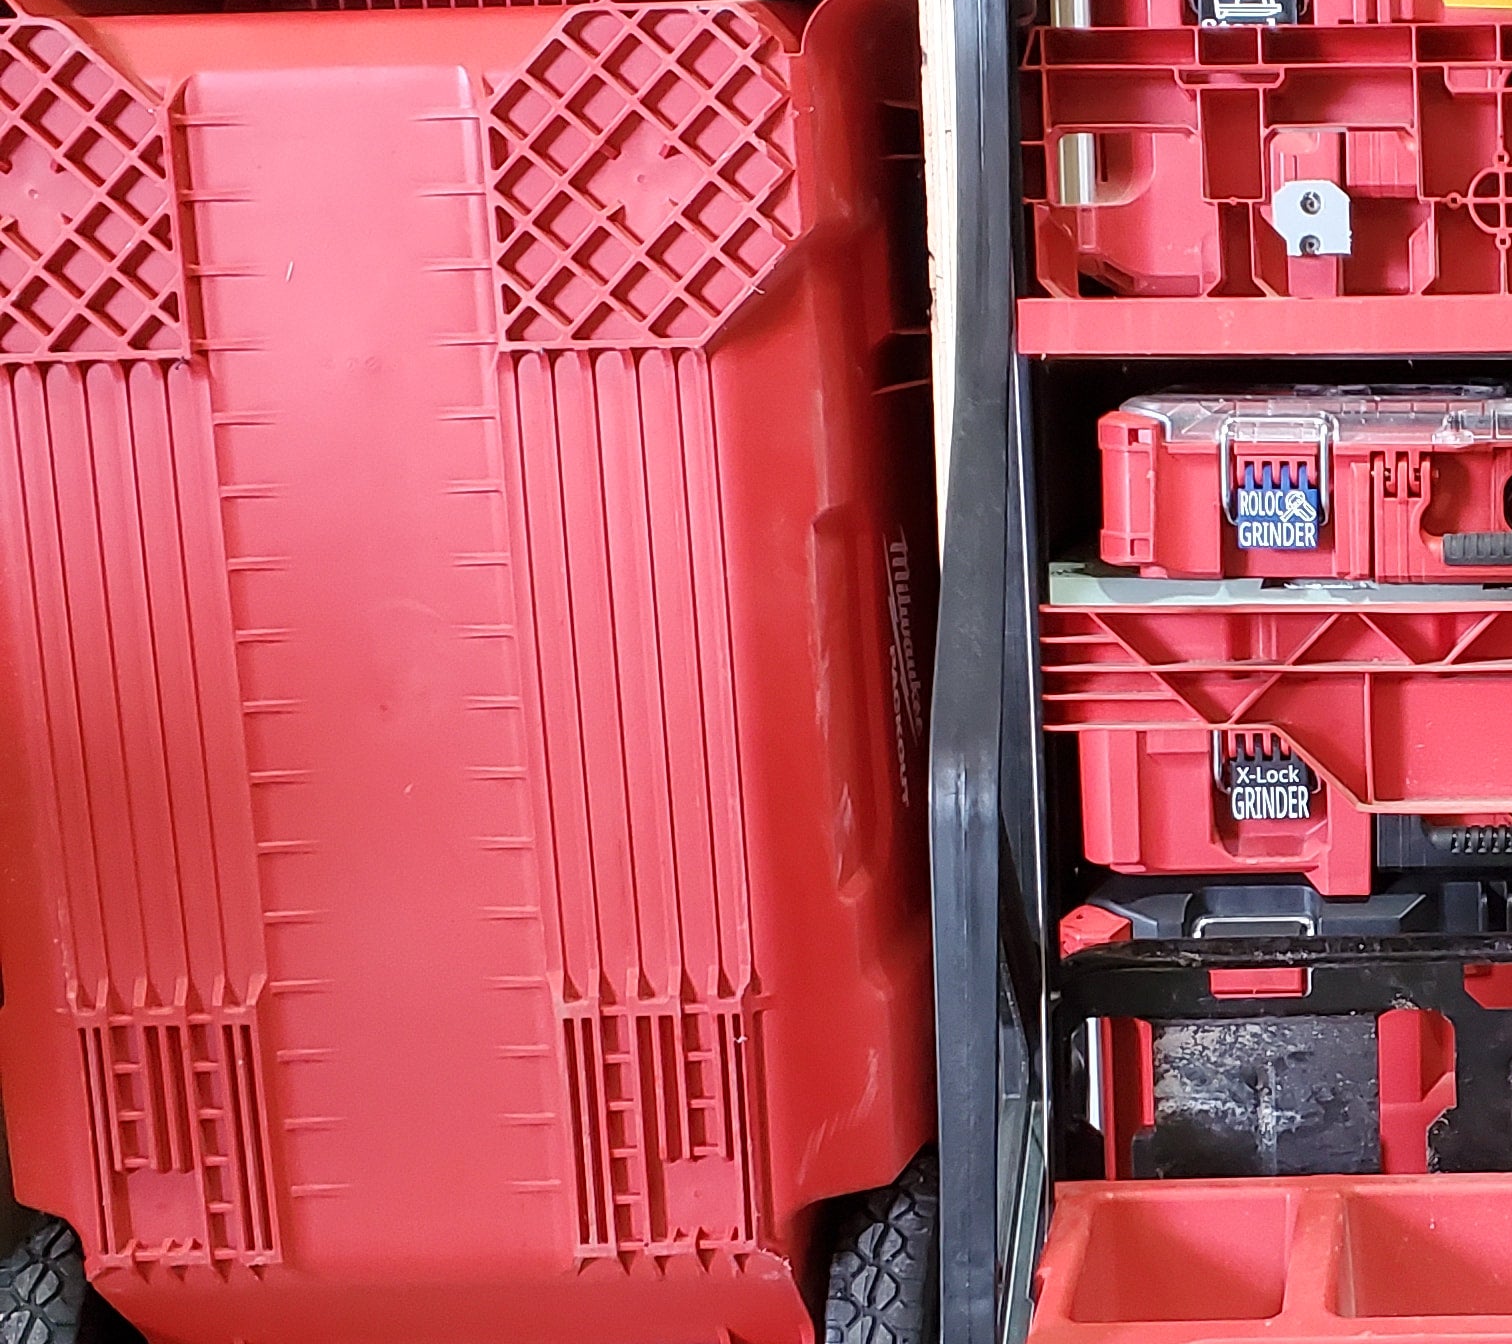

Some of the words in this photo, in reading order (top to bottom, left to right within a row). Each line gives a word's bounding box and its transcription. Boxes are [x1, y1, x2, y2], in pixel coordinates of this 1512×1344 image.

[1240, 491, 1284, 516] ROLOC
[1240, 522, 1316, 547] GRINDER
[1236, 765, 1300, 784] X-Lock
[1232, 786, 1310, 820] GRINDER
